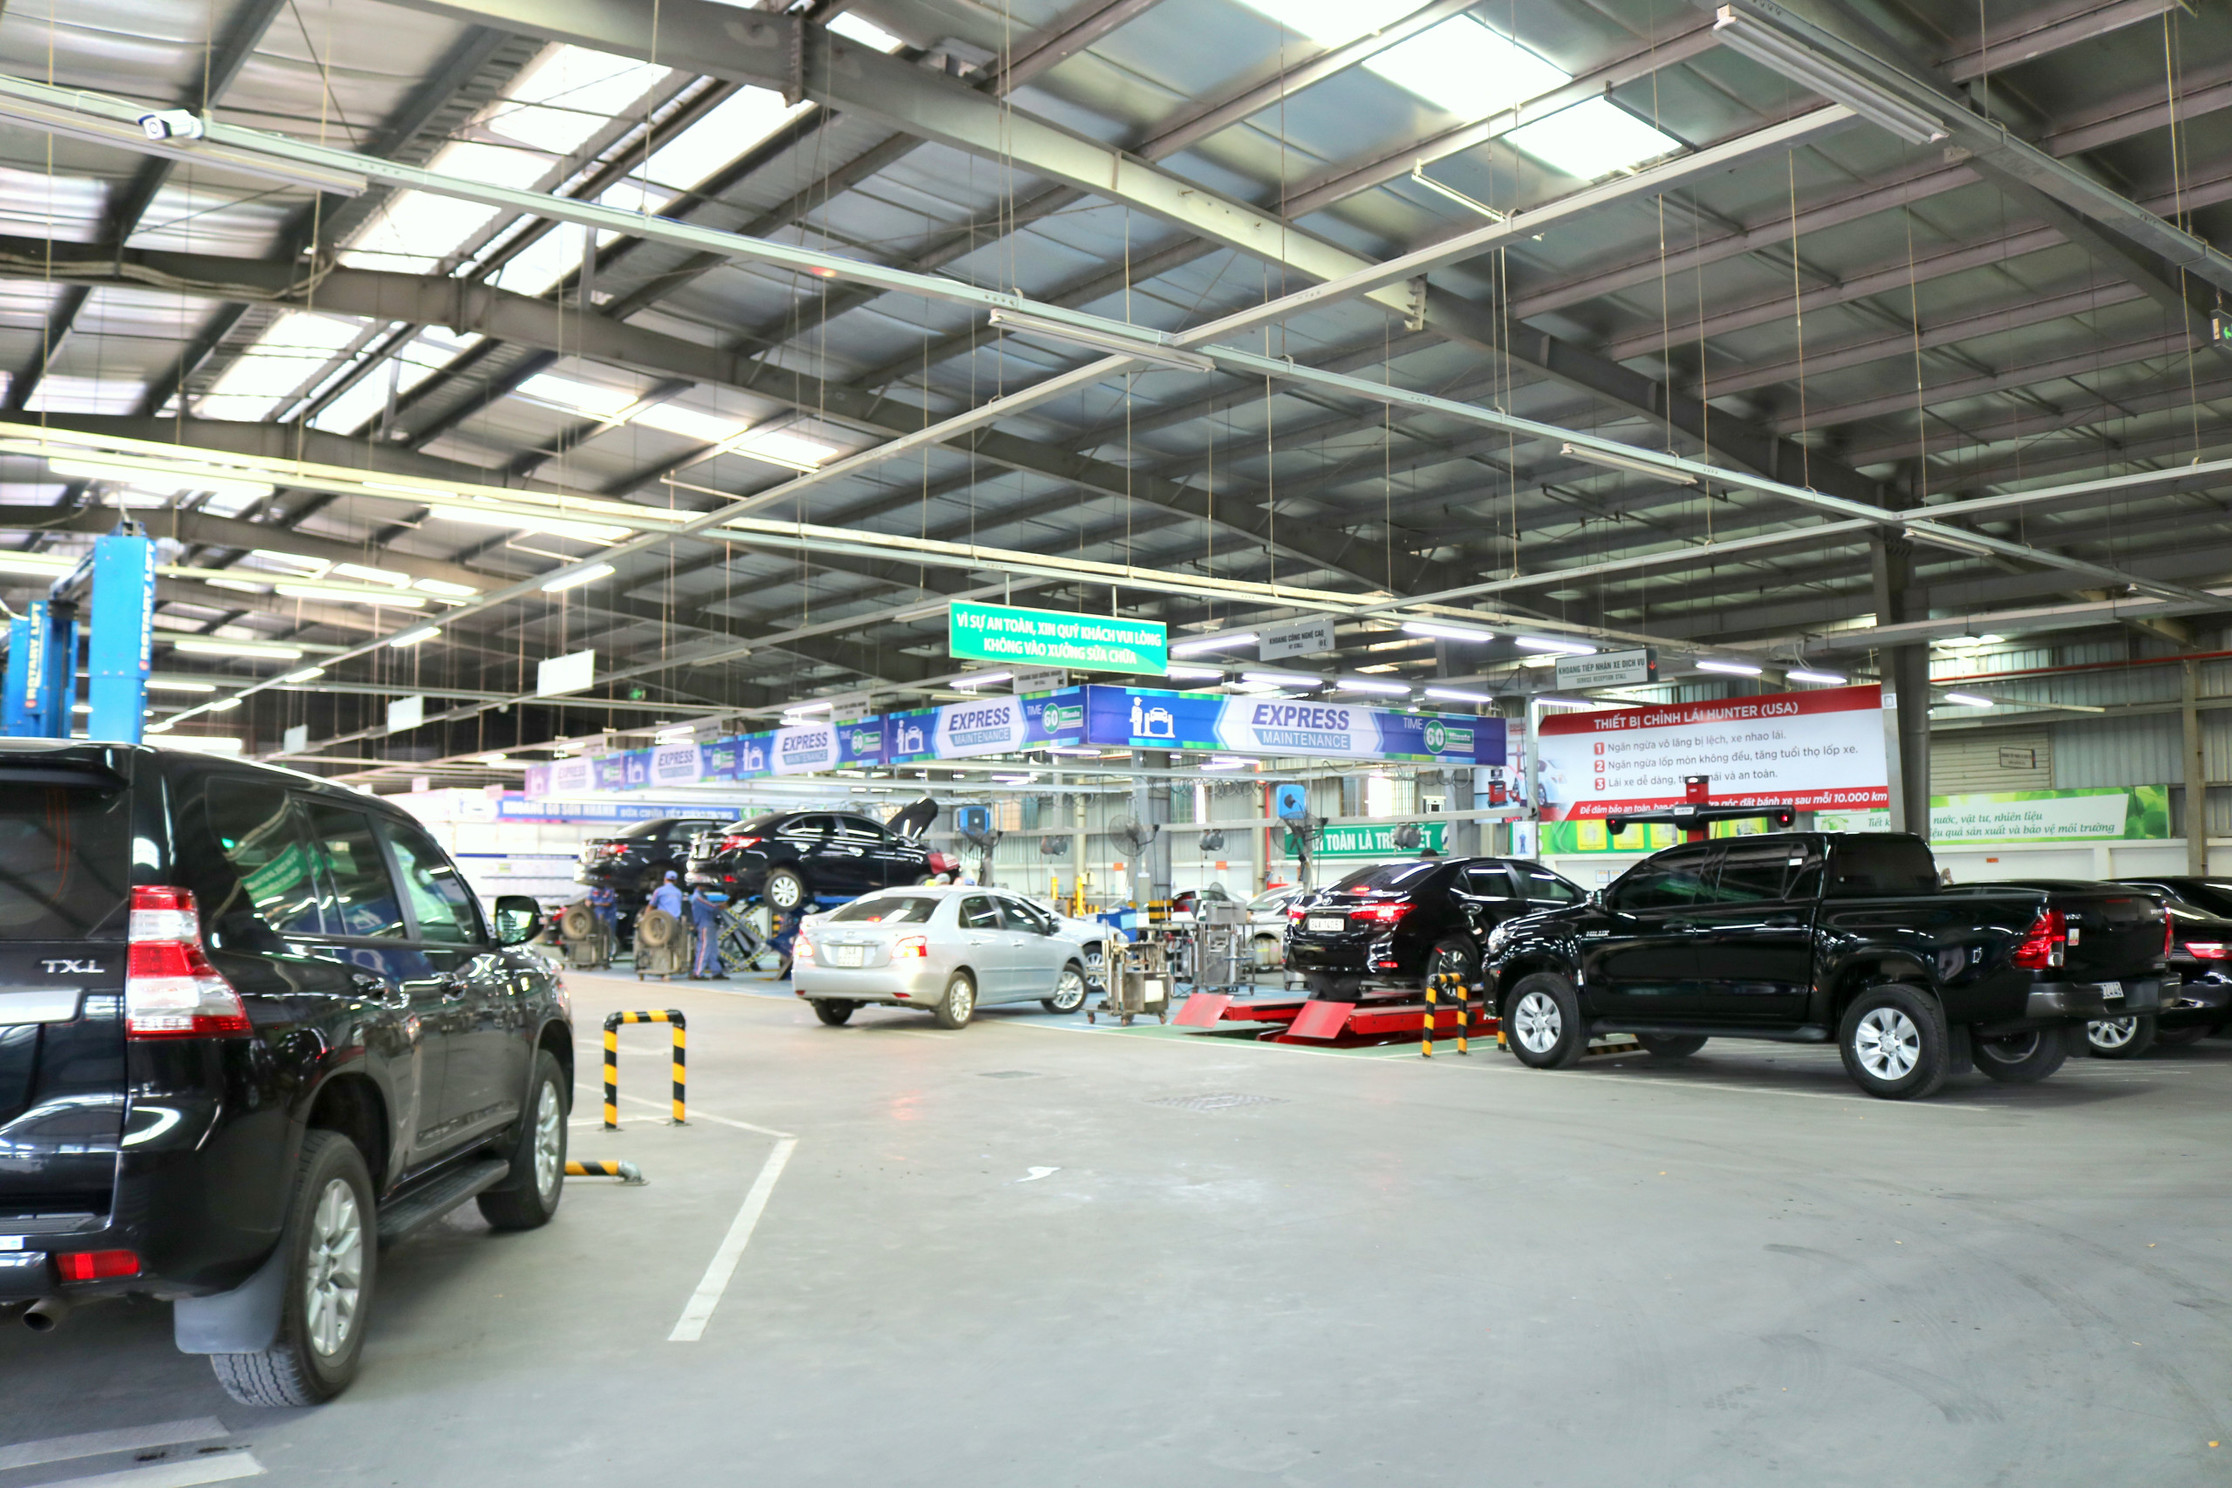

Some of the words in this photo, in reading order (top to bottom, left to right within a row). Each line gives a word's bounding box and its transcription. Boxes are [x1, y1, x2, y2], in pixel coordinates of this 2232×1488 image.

[956, 612, 968, 627] VÌ
[970, 615, 986, 632] SỰ
[987, 617, 1002, 630] AN
[1004, 618, 1035, 636] TOÀN,
[1038, 622, 1055, 636] XIN
[1057, 624, 1079, 639] QUÝ
[1081, 626, 1116, 642] KHÁCH
[1117, 631, 1133, 644] VUI
[1135, 631, 1162, 647] LÒNG
[984, 638, 1023, 654] KHÔNG
[1024, 640, 1047, 656] VÀO
[1048, 643, 1085, 660] XƯỞNG
[1087, 646, 1107, 662] SỬA
[1109, 648, 1137, 664] CHỮA
[1558, 666, 1581, 674] KHOANG
[1613, 660, 1621, 669] XE
[1027, 704, 1042, 716] TIME
[1252, 704, 1350, 731] EXPRESS
[1594, 713, 1626, 730] THIẾT
[1629, 715, 1641, 729] BỊ
[1644, 709, 1681, 726] CHỈNH
[1684, 708, 1704, 722] LÁI
[1706, 705, 1758, 720] HUNTER
[1761, 702, 1799, 717] (USA)
[949, 707, 1010, 731] EXPRESS
[1044, 710, 1058, 727] 60
[1403, 717, 1423, 730] TIME
[783, 731, 828, 752] EXPRESS
[852, 736, 864, 749] 60
[954, 729, 1009, 744] MAINTENANCE
[1263, 731, 1349, 749] MAINTENANCE
[1426, 727, 1444, 746] 60
[1597, 744, 1602, 754] 1
[1608, 743, 1631, 753] Ngăn
[1633, 741, 1656, 752] ngừa
[1672, 737, 1692, 749] lăng
[1695, 736, 1704, 747] bị
[1706, 734, 1729, 746] lệch,
[1731, 735, 1743, 743] xe
[1745, 732, 1769, 742] nhao
[1772, 730, 1786, 740] lái.
[658, 749, 694, 766] EXPRESS
[1596, 761, 1603, 771] 2
[1608, 761, 1631, 771] Ngăn
[1634, 758, 1656, 769] ngừa
[1659, 756, 1673, 767] lốp
[1676, 756, 1697, 765] mòn
[1700, 754, 1729, 764] không
[1732, 750, 1753, 761] đều,
[1755, 750, 1778, 761] tăng
[1780, 746, 1800, 758] tuổi
[1803, 746, 1820, 758] thọ
[1823, 744, 1840, 755] lốp
[1843, 745, 1858, 754] xe.
[1597, 779, 1604, 789] 3
[1608, 777, 1621, 787] Lái
[1624, 778, 1634, 786] xe
[1636, 774, 1648, 786] dễ
[1650, 776, 1676, 786] dàng,
[1724, 771, 1736, 780] và
[1738, 771, 1750, 780] an
[1753, 769, 1778, 779] toàn.
[1757, 796, 1780, 807] bánh
[1781, 798, 1793, 806] xe
[1794, 796, 1812, 805] sau
[1813, 791, 1832, 805] mỗi
[1834, 792, 1869, 803] 10.000
[1871, 791, 1888, 801] km
[1580, 804, 1591, 815] Để
[1591, 804, 1607, 814] đảm
[1608, 804, 1622, 814] bảo
[1933, 814, 1958, 825] nước,
[1961, 813, 1976, 825] vật
[1994, 812, 2021, 822] nhiên
[2024, 810, 2043, 822] liệu
[1869, 817, 1882, 827] Tiết
[1945, 826, 1963, 838] quả
[1966, 826, 1982, 836] sản
[1984, 824, 2006, 836] xuất
[2008, 825, 2021, 835] và
[2023, 824, 2042, 834] bảo
[2044, 824, 2056, 835] vệ
[2058, 823, 2077, 833] môi
[2080, 823, 2115, 834] trường
[1326, 830, 1356, 851] TOÀN
[1358, 830, 1373, 850] LÀ
[41, 960, 105, 974] TXL
